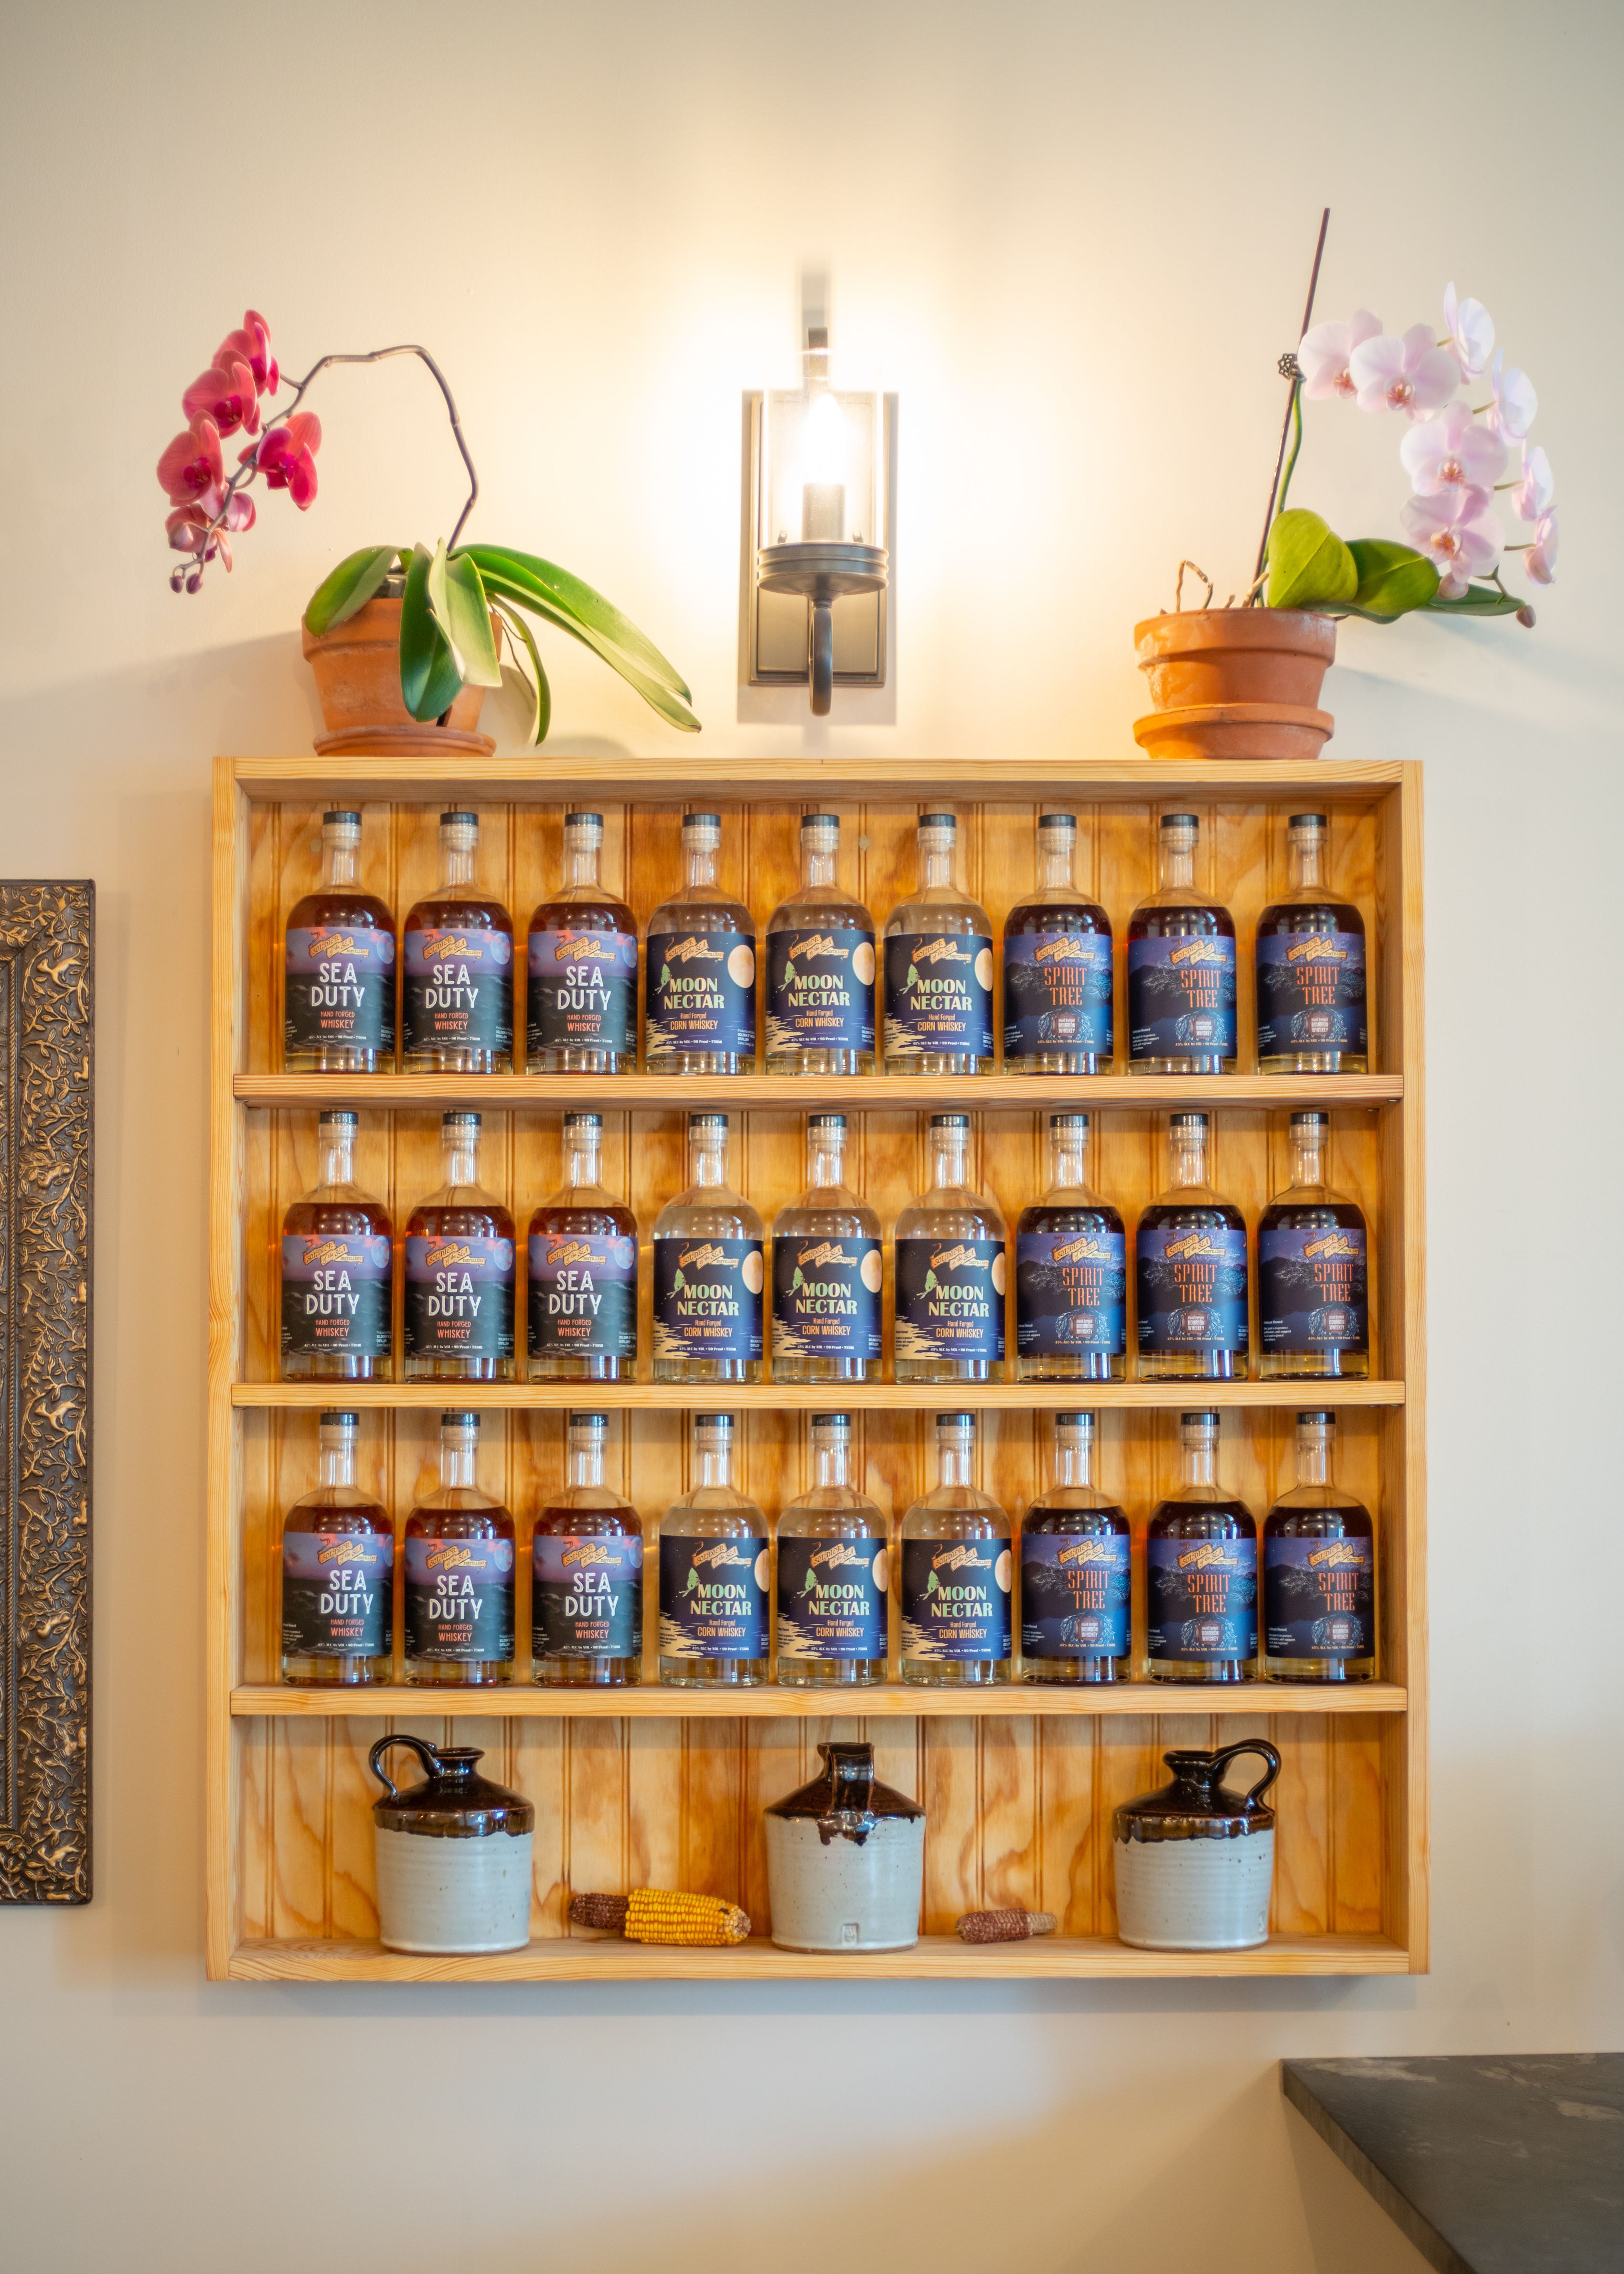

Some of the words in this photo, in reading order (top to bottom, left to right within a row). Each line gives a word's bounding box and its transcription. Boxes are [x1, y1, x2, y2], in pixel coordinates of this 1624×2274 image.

[320, 963, 357, 983] SEA
[433, 965, 470, 985] SEA
[566, 966, 604, 986] SEA
[1044, 967, 1088, 986] SPIRIT
[1182, 970, 1222, 988] SPIRIT
[1297, 966, 1340, 985] SPIRIT
[669, 977, 717, 992] MOON
[794, 975, 843, 989] MOON
[918, 979, 966, 994] MOON
[311, 986, 365, 1007] DUTY
[426, 988, 479, 1008] DUTY
[558, 989, 612, 1010] DUTY
[663, 994, 724, 1009] NECTAR
[788, 992, 850, 1006] NECTAR
[911, 996, 972, 1010] NECTAR
[1050, 987, 1082, 1005] TREE
[1188, 990, 1218, 1008] TREE
[1303, 987, 1336, 1004] TREE
[819, 1009, 833, 1018] Forged
[941, 1014, 955, 1022] Forged
[321, 1019, 354, 1029] WHISKEY
[435, 1021, 468, 1030] WHISKEY
[567, 1022, 601, 1032] WHISKEY
[670, 1021, 687, 1030] CORN
[688, 1020, 718, 1030] WHISKEY
[796, 1018, 813, 1027] CORN
[815, 1018, 844, 1027] WHISKEY
[918, 1022, 935, 1031] CORN
[938, 1022, 966, 1031] WHISKEY
[1063, 1267, 1105, 1286] SPIRIT
[1174, 1264, 1218, 1282] SPIRIT
[1315, 1264, 1355, 1282] SPIRIT
[314, 1271, 351, 1291] SEA
[436, 1272, 473, 1293] SEA
[557, 1271, 594, 1291] SEA
[684, 1285, 732, 1299] MOON
[802, 1283, 851, 1298] MOON
[937, 1286, 984, 1300] MOON
[1068, 1288, 1100, 1306] TREE
[1179, 1284, 1212, 1302] TREE
[1321, 1284, 1351, 1301] TREE
[306, 1294, 360, 1315] DUTY
[428, 1296, 481, 1317] DUTY
[549, 1294, 602, 1315] DUTY
[677, 1301, 739, 1316] NECTAR
[796, 1299, 857, 1314] NECTAR
[930, 1302, 991, 1317] NECTAR
[825, 1318, 840, 1326] Forged
[960, 1320, 974, 1329] Forged
[316, 1327, 349, 1337] WHISKEY
[437, 1329, 470, 1338] WHISKEY
[558, 1327, 591, 1337] WHISKEY
[684, 1328, 702, 1337] CORN
[704, 1327, 732, 1337] WHISKEY
[802, 1326, 820, 1335] CORN
[822, 1326, 851, 1335] WHISKEY
[936, 1328, 954, 1337] CORN
[957, 1328, 983, 1338] WHISKEY
[331, 1570, 367, 1590] SEA
[438, 1575, 474, 1596] SEA
[574, 1573, 611, 1593] SEA
[1068, 1570, 1111, 1588] SPIRIT
[1188, 1574, 1231, 1592] SPIRIT
[1319, 1572, 1360, 1591] SPIRIT
[698, 1584, 747, 1599] MOON
[816, 1584, 865, 1599] MOON
[938, 1586, 987, 1601] MOON
[322, 1594, 375, 1614] DUTY
[566, 1596, 620, 1617] DUTY
[1073, 1591, 1106, 1609] TREE
[1193, 1595, 1226, 1613] TREE
[1325, 1593, 1356, 1610] TREE
[429, 1599, 482, 1620] DUTY
[691, 1601, 753, 1615] NECTAR
[809, 1601, 871, 1616] NECTAR
[932, 1603, 994, 1618] NECTAR
[331, 1627, 364, 1636] WHISKEY
[840, 1620, 854, 1628] Forged
[439, 1632, 472, 1641] WHISKEY
[576, 1630, 609, 1639] WHISKEY
[697, 1627, 716, 1636] CORN
[718, 1627, 746, 1637] WHISKEY
[816, 1628, 834, 1637] CORN
[836, 1627, 864, 1637] WHISKEY
[939, 1630, 957, 1639] CORN
[959, 1629, 987, 1639] WHISKEY
